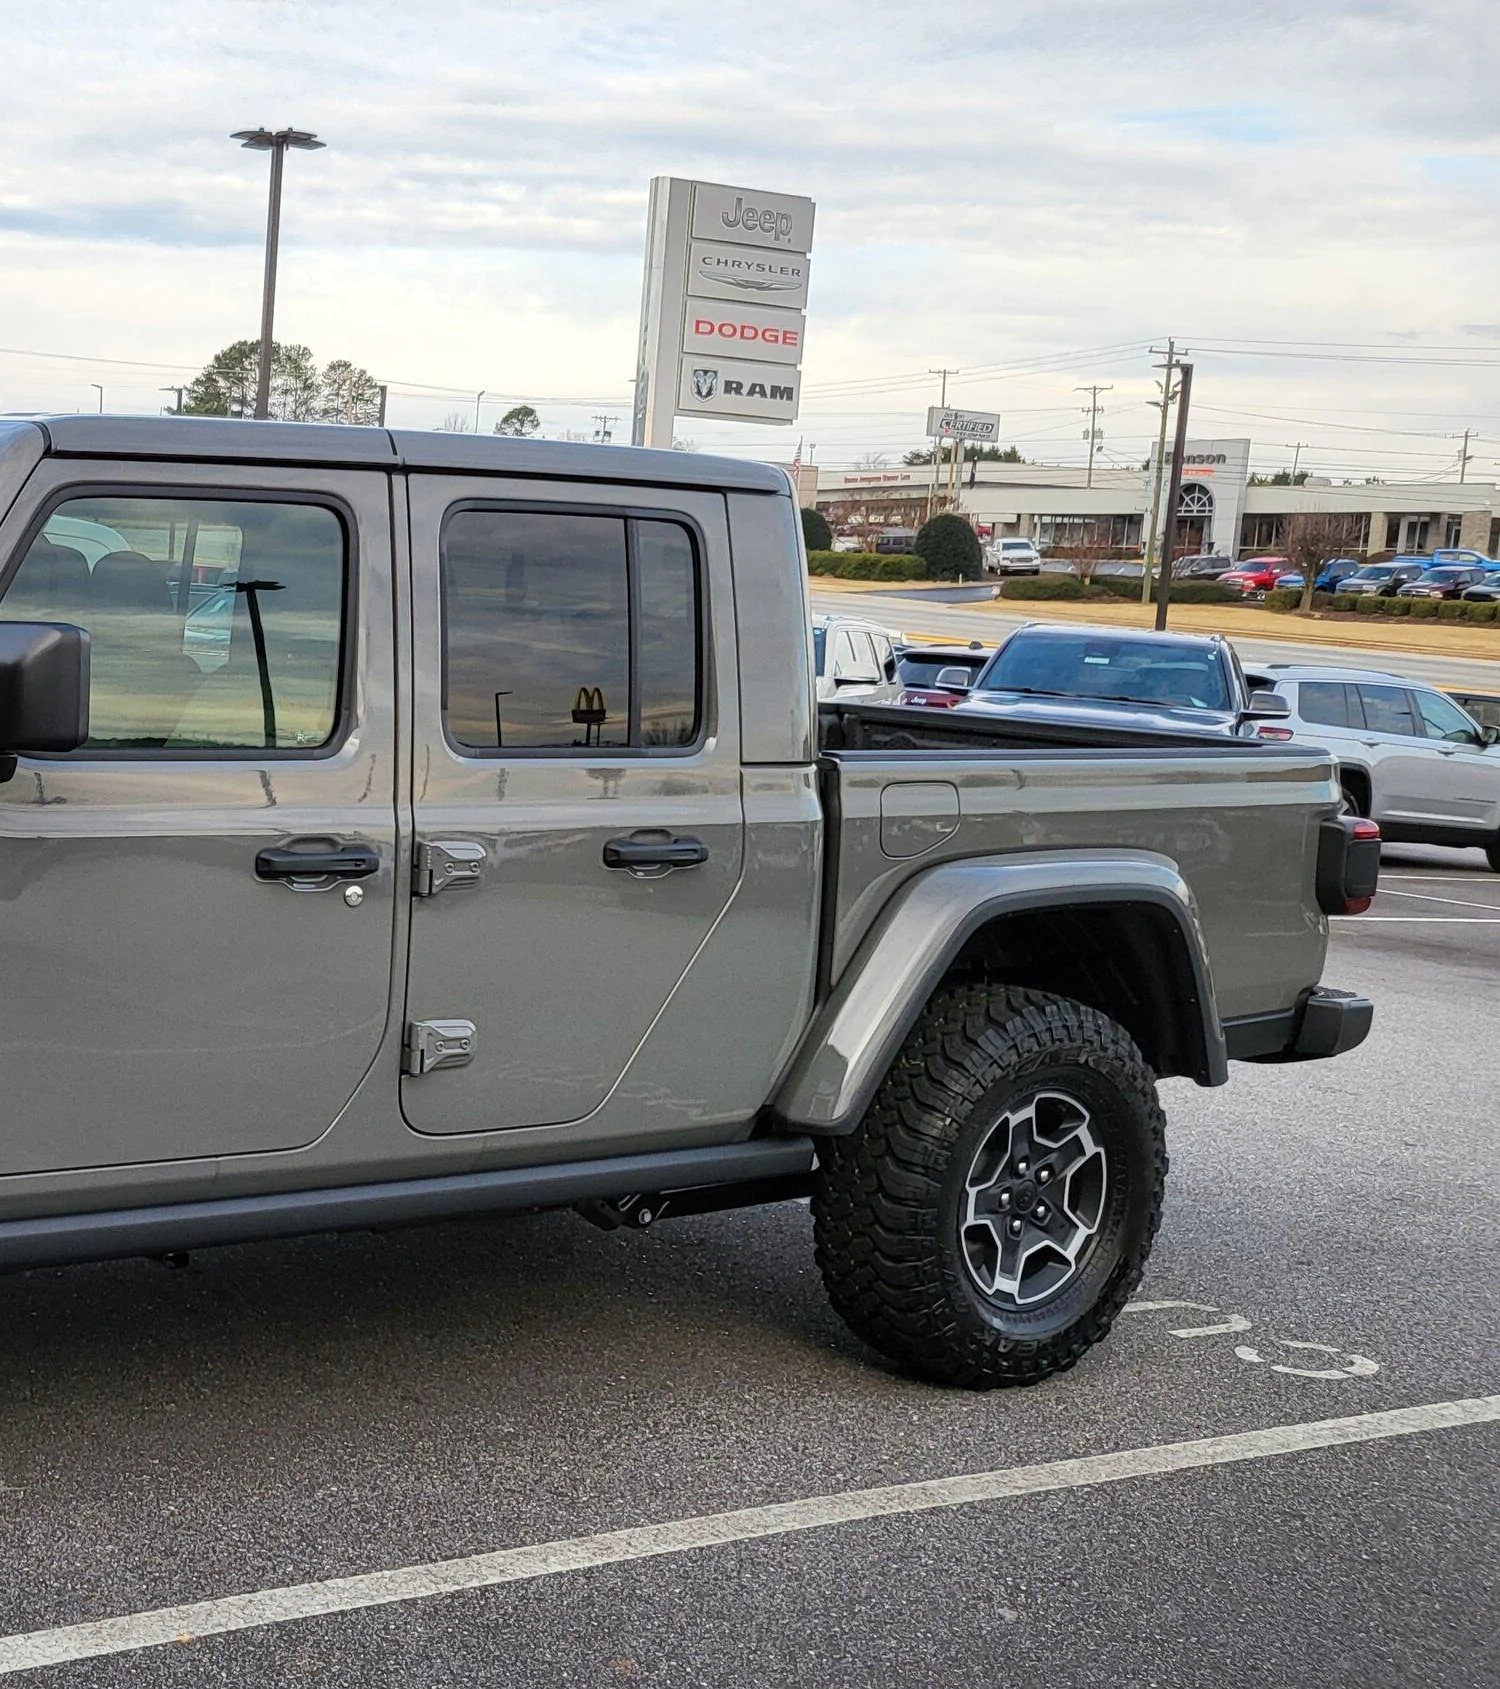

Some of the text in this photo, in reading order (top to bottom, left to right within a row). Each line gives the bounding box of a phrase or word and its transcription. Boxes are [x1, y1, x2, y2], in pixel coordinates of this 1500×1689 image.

[721, 197, 792, 241] Jeep
[702, 256, 801, 277] CHRYSLER
[694, 319, 798, 346] DODGE
[723, 380, 794, 401] RAM
[941, 419, 993, 433] CERTIFIED
